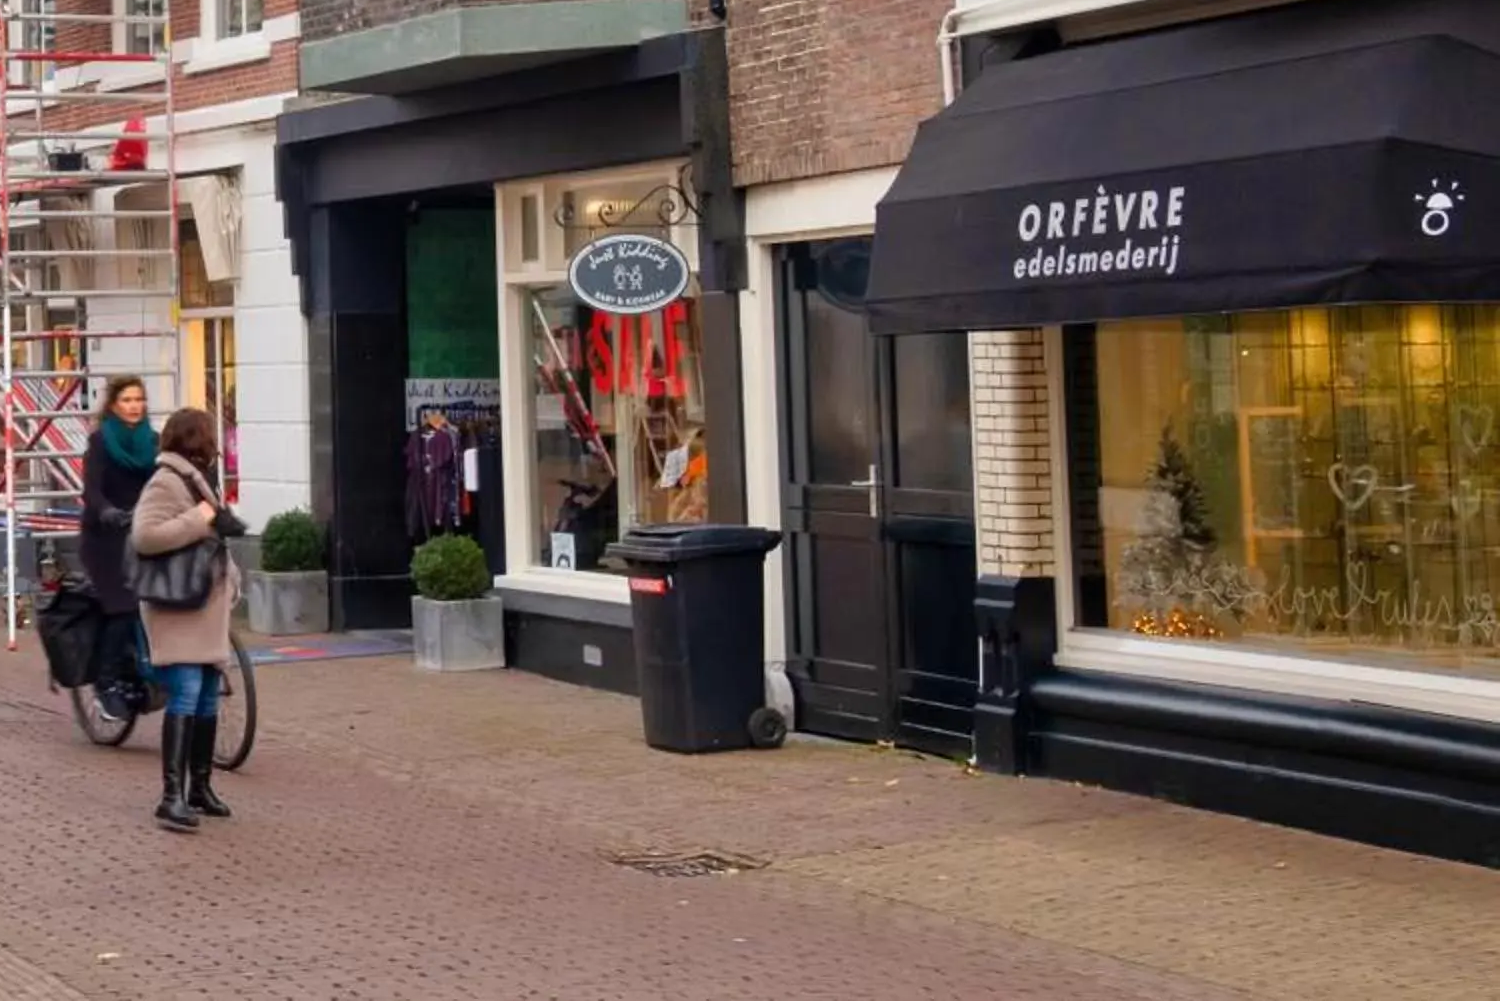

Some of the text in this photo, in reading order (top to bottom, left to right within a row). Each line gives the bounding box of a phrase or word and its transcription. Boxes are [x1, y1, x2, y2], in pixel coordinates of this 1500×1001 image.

[1018, 184, 1186, 242] ORFÈVRE
[589, 242, 669, 271] Just Kidding
[1013, 234, 1180, 280] edelsmederij
[588, 299, 688, 397] SALE
